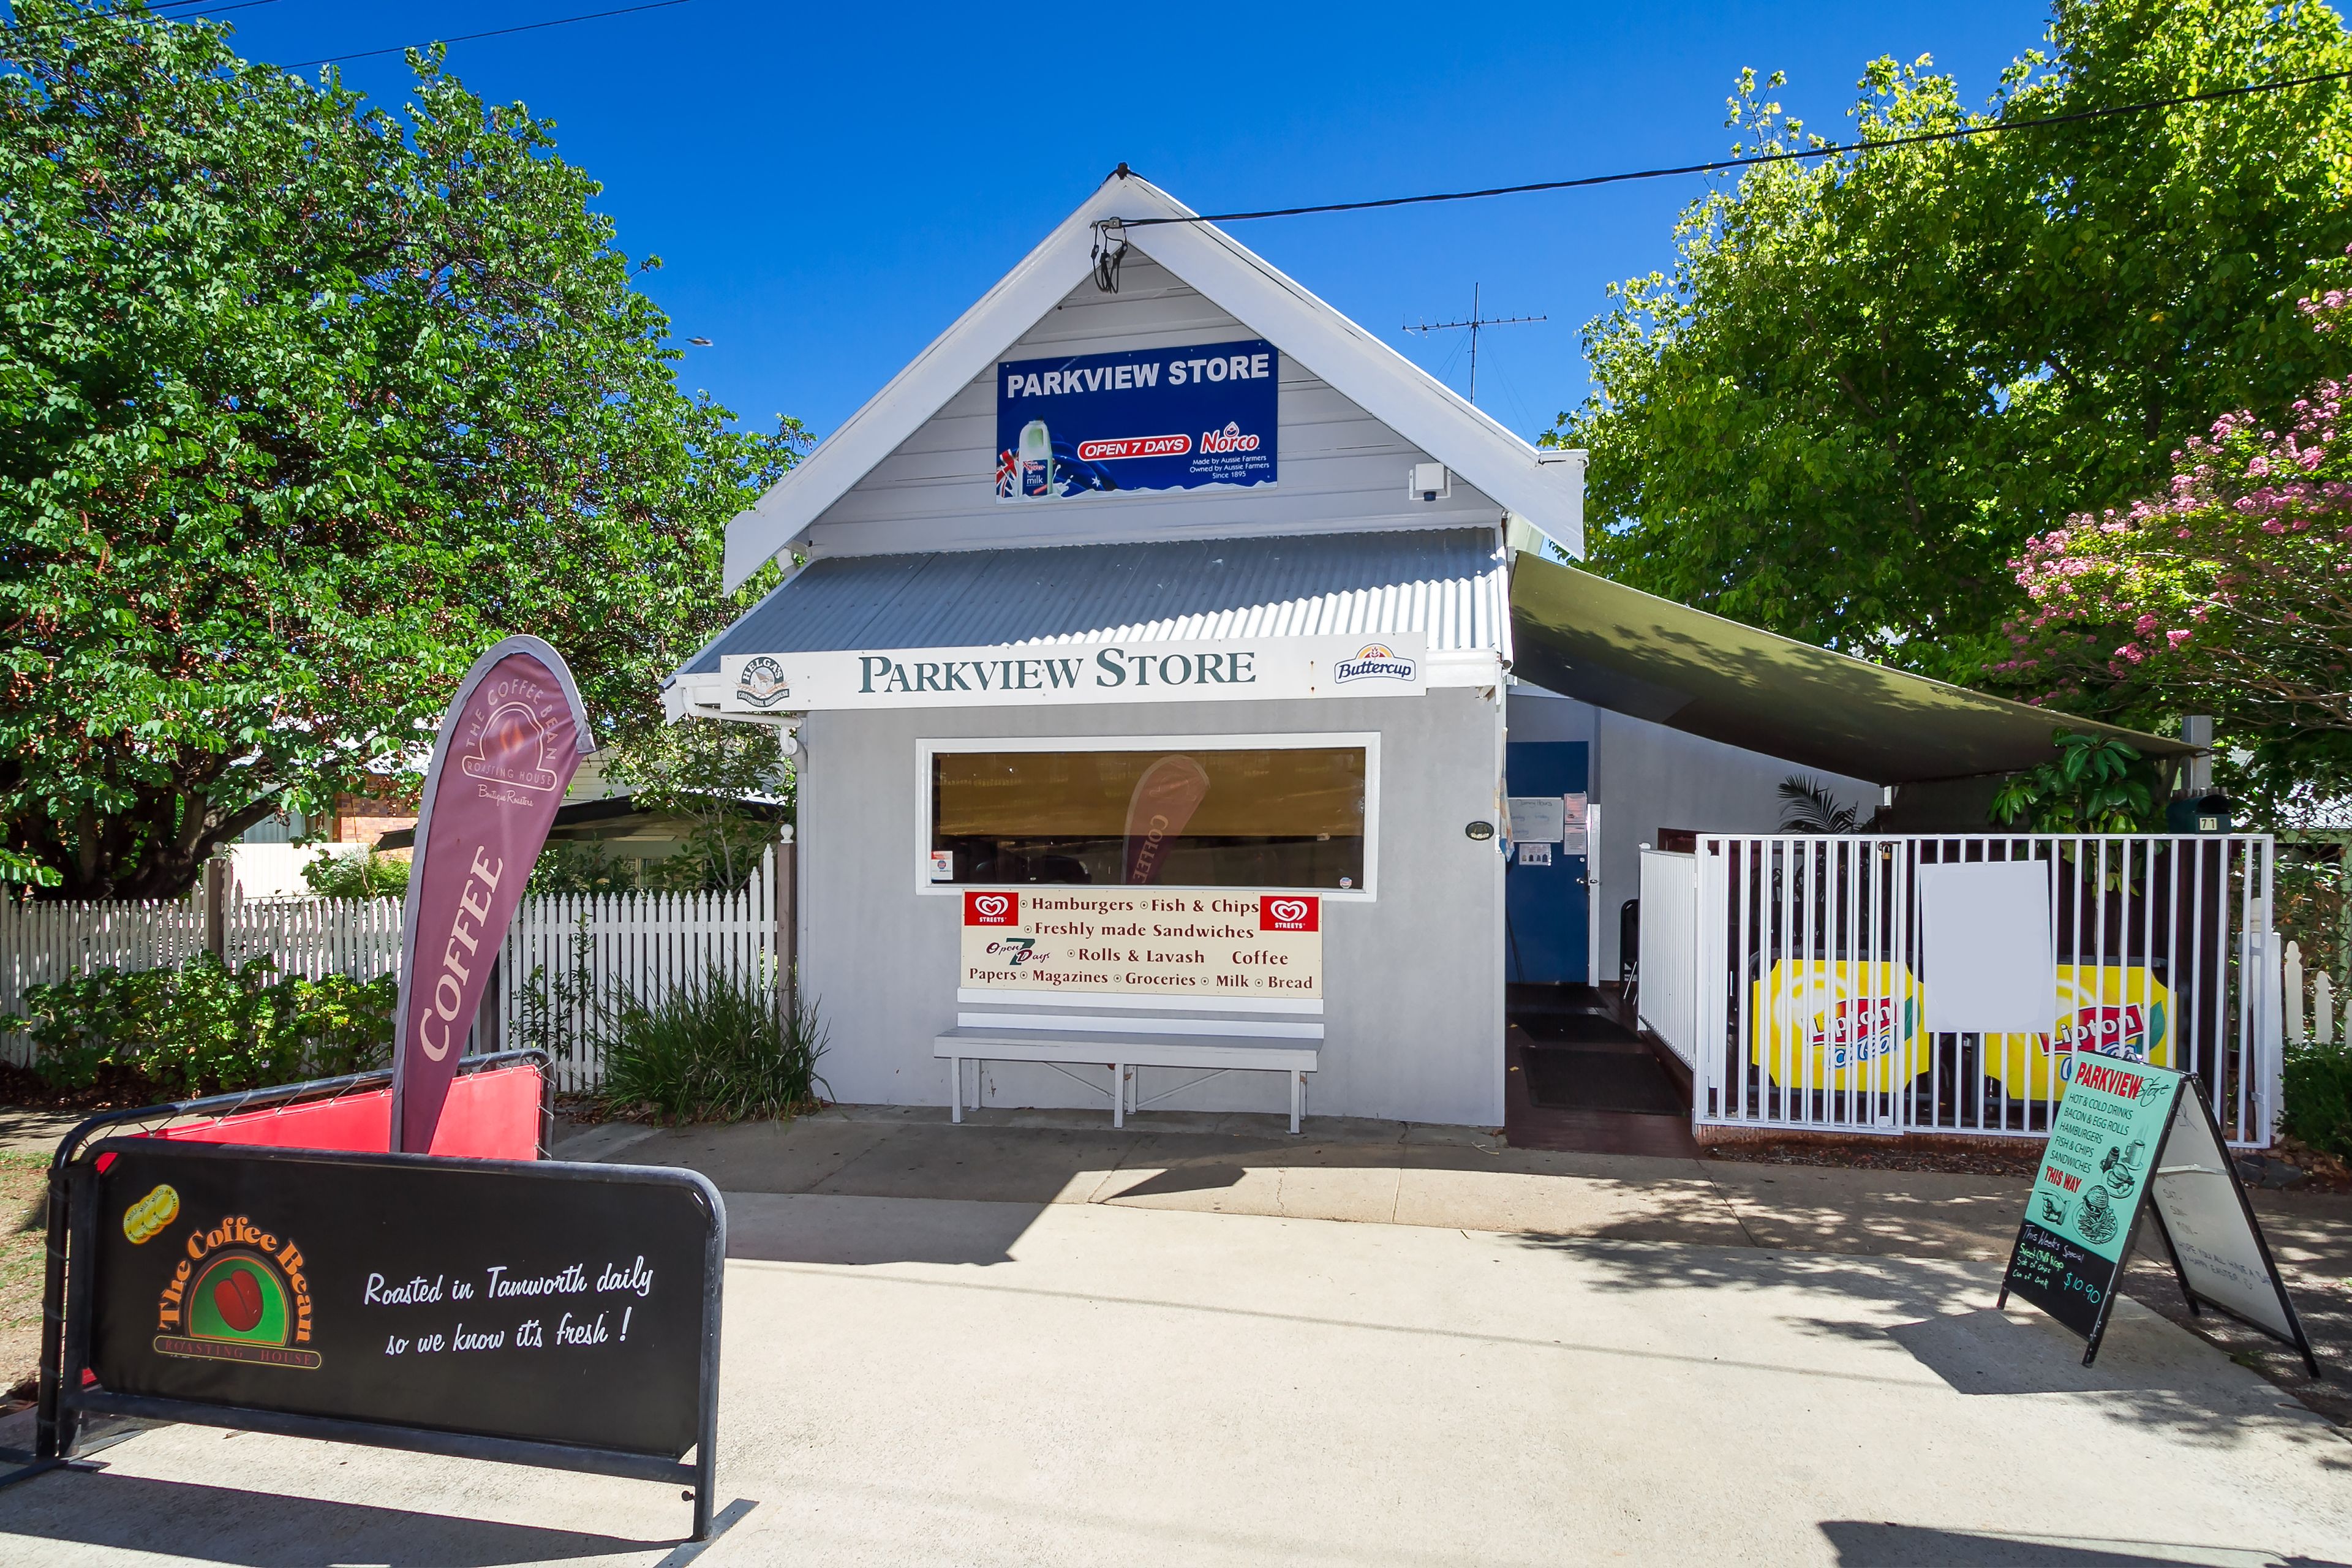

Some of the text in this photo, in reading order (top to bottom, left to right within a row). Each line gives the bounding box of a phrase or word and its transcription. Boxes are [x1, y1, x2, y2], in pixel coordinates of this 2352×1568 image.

[1007, 353, 1270, 399] PARKVIEW STORE
[1085, 439, 1185, 457] OPEN 7 DAYS
[1200, 429, 1259, 454] Norco
[1027, 475, 1044, 484] milk
[742, 658, 783, 681] HELGA'S
[1338, 660, 1412, 679] Buttercup
[466, 678, 559, 761] THE COFFEE BEAN
[467, 761, 552, 785] ROASTING HOUSE
[2201, 818, 2215, 829] 71
[1032, 897, 1259, 917] Hamburgers Fish & Chips
[1035, 922, 1255, 939] Freshly made Sandwiches
[420, 845, 503, 1062] COFFEE
[986, 942, 1020, 956] Open
[1017, 949, 1050, 963] Days
[1079, 948, 1289, 965] Rolls & Lavash Coffee
[970, 968, 1313, 989] Papers Magazines Groceries Milk Bread
[1801, 1006, 1896, 1038] Lpon
[2074, 1061, 2144, 1100] PARKVIEW
[2135, 1076, 2171, 1107] Store
[2068, 1093, 2134, 1120] HOT & COLD DRINKS
[2059, 1121, 2104, 1145] HAMBURGERS
[2064, 1107, 2130, 1136] BACON & EGG ROLLS
[2054, 1135, 2095, 1158] FISH & CHIPS
[2049, 1150, 2092, 1174] SANDWICHES
[2044, 1165, 2083, 1194] THIS WAY
[2022, 1224, 2038, 1241] This
[2029, 1259, 2038, 1268] of
[157, 1216, 313, 1344] The Coffee Bean
[364, 1255, 654, 1305] Roasted in Tamworth daily
[385, 1334, 409, 1355] so
[417, 1332, 445, 1353] we
[453, 1323, 505, 1352] know
[556, 1312, 609, 1346] fresh
[165, 1339, 312, 1366] ROASTING HOUSE
